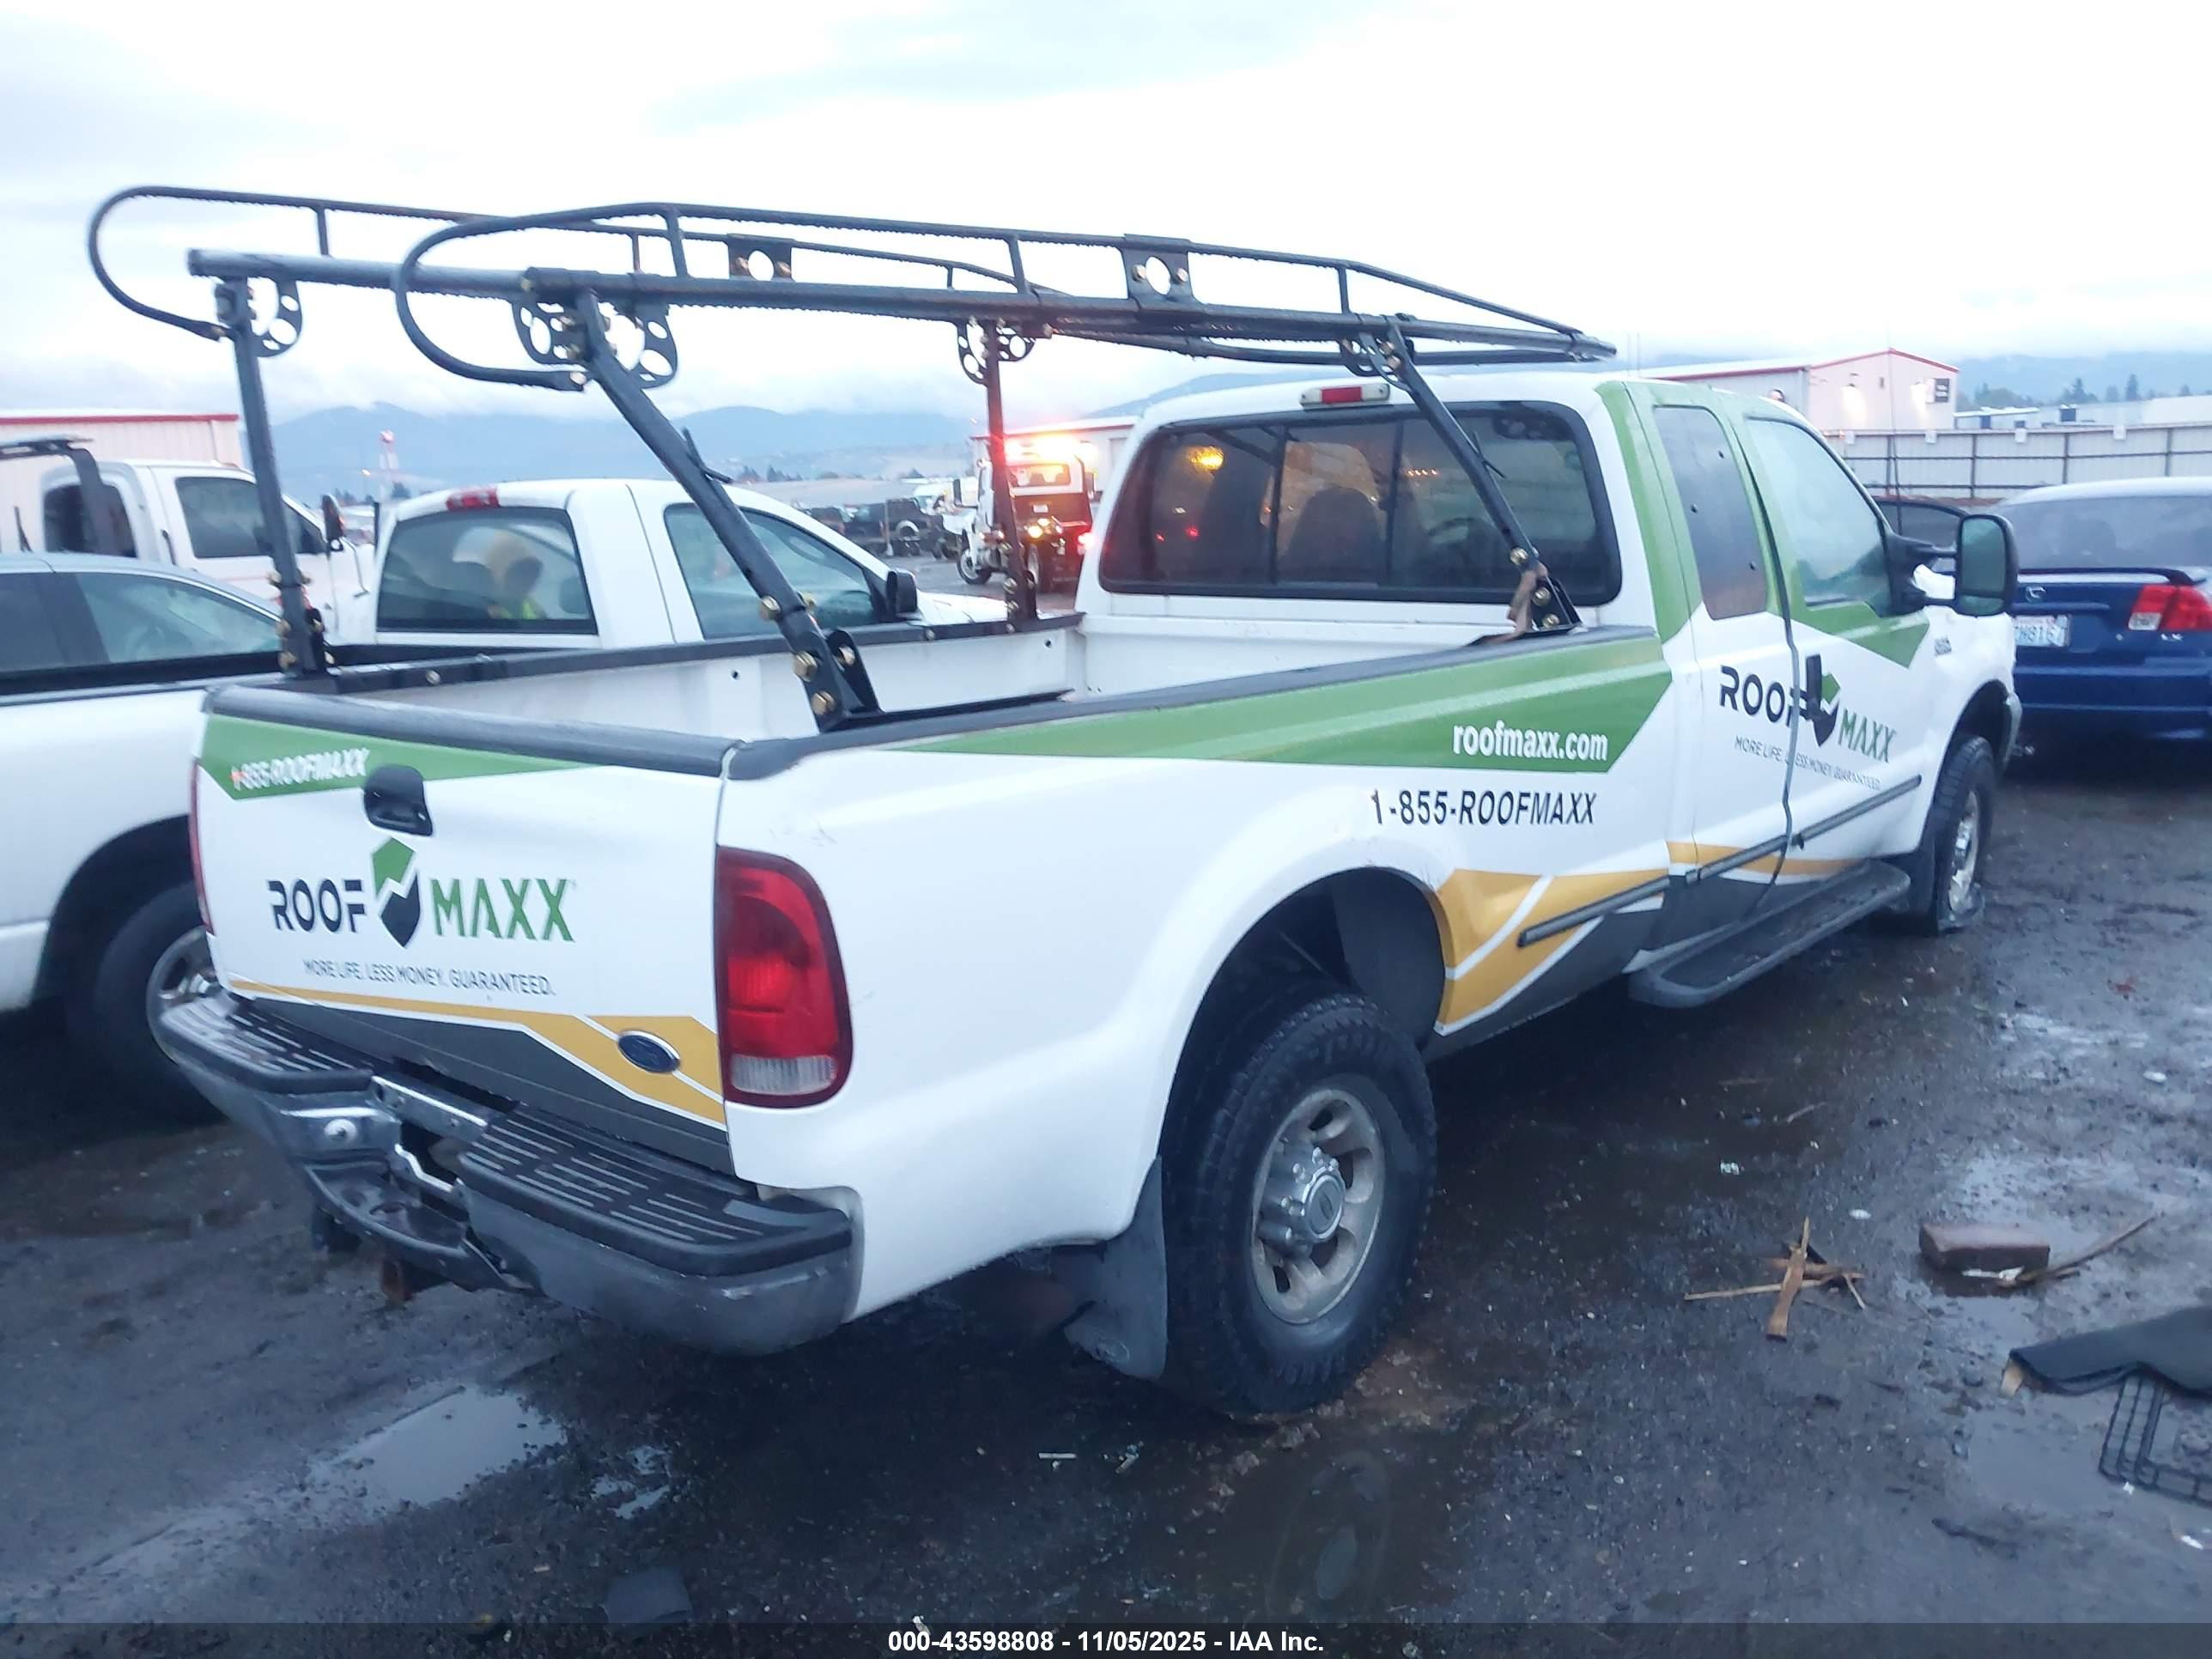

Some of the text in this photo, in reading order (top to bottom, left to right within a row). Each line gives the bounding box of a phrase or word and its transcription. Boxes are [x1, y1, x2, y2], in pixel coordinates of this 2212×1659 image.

[1453, 720, 1608, 761] roofmaxx.com
[1838, 708, 1897, 763] MAXX
[1371, 789, 1597, 825] 1-855-ROOFMAXX
[267, 878, 574, 942] ROOF MAXX
[303, 959, 336, 978] MORE
[365, 963, 394, 983] LESS
[450, 969, 556, 996] GUARANTEED.
